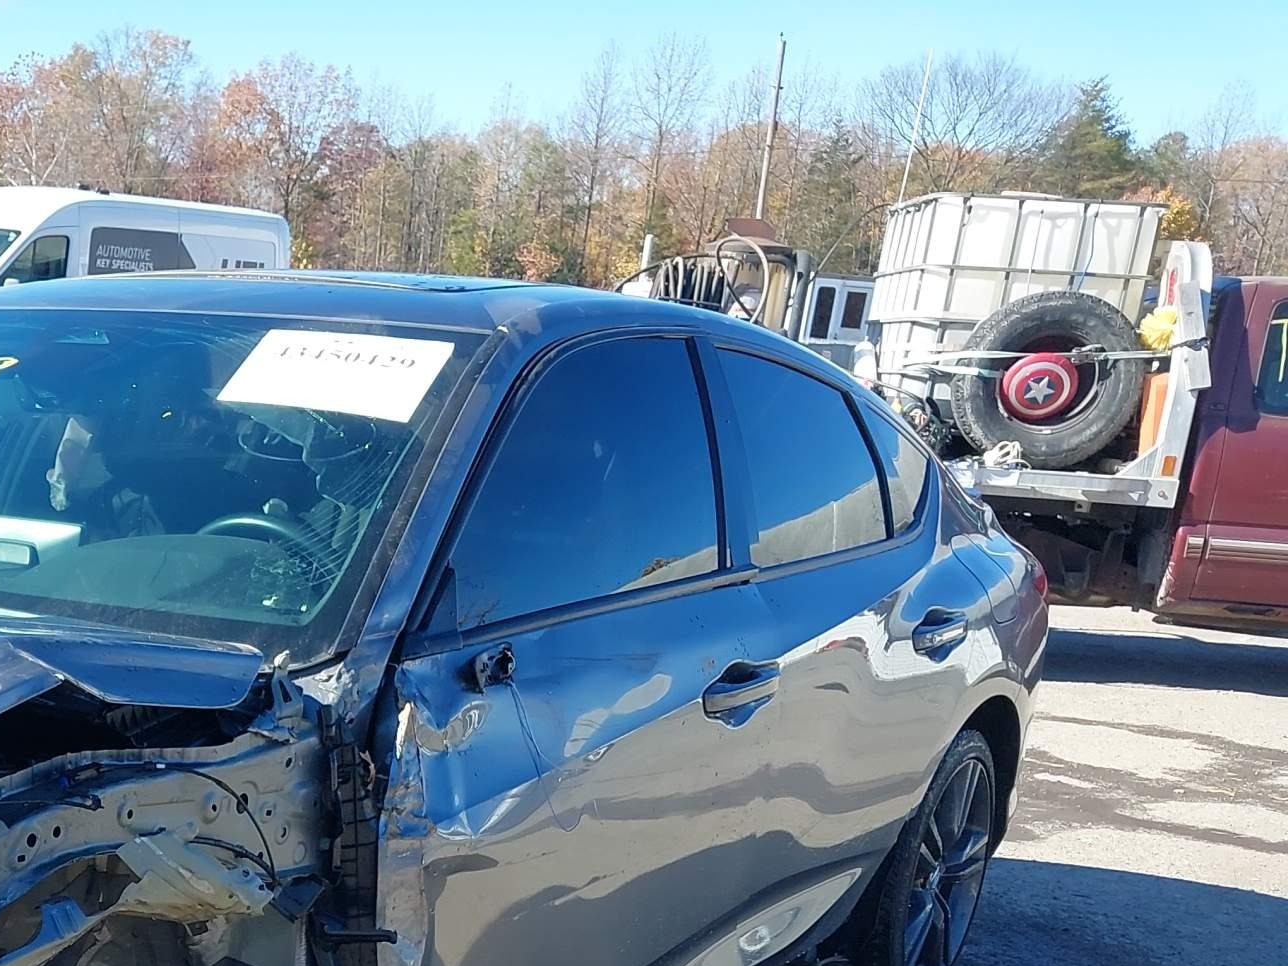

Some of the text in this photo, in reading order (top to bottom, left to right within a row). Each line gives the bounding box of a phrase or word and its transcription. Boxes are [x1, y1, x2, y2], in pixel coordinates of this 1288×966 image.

[96, 244, 152, 261] AUTOMOTIVE
[96, 258, 154, 272] KEY SPECIALISTS
